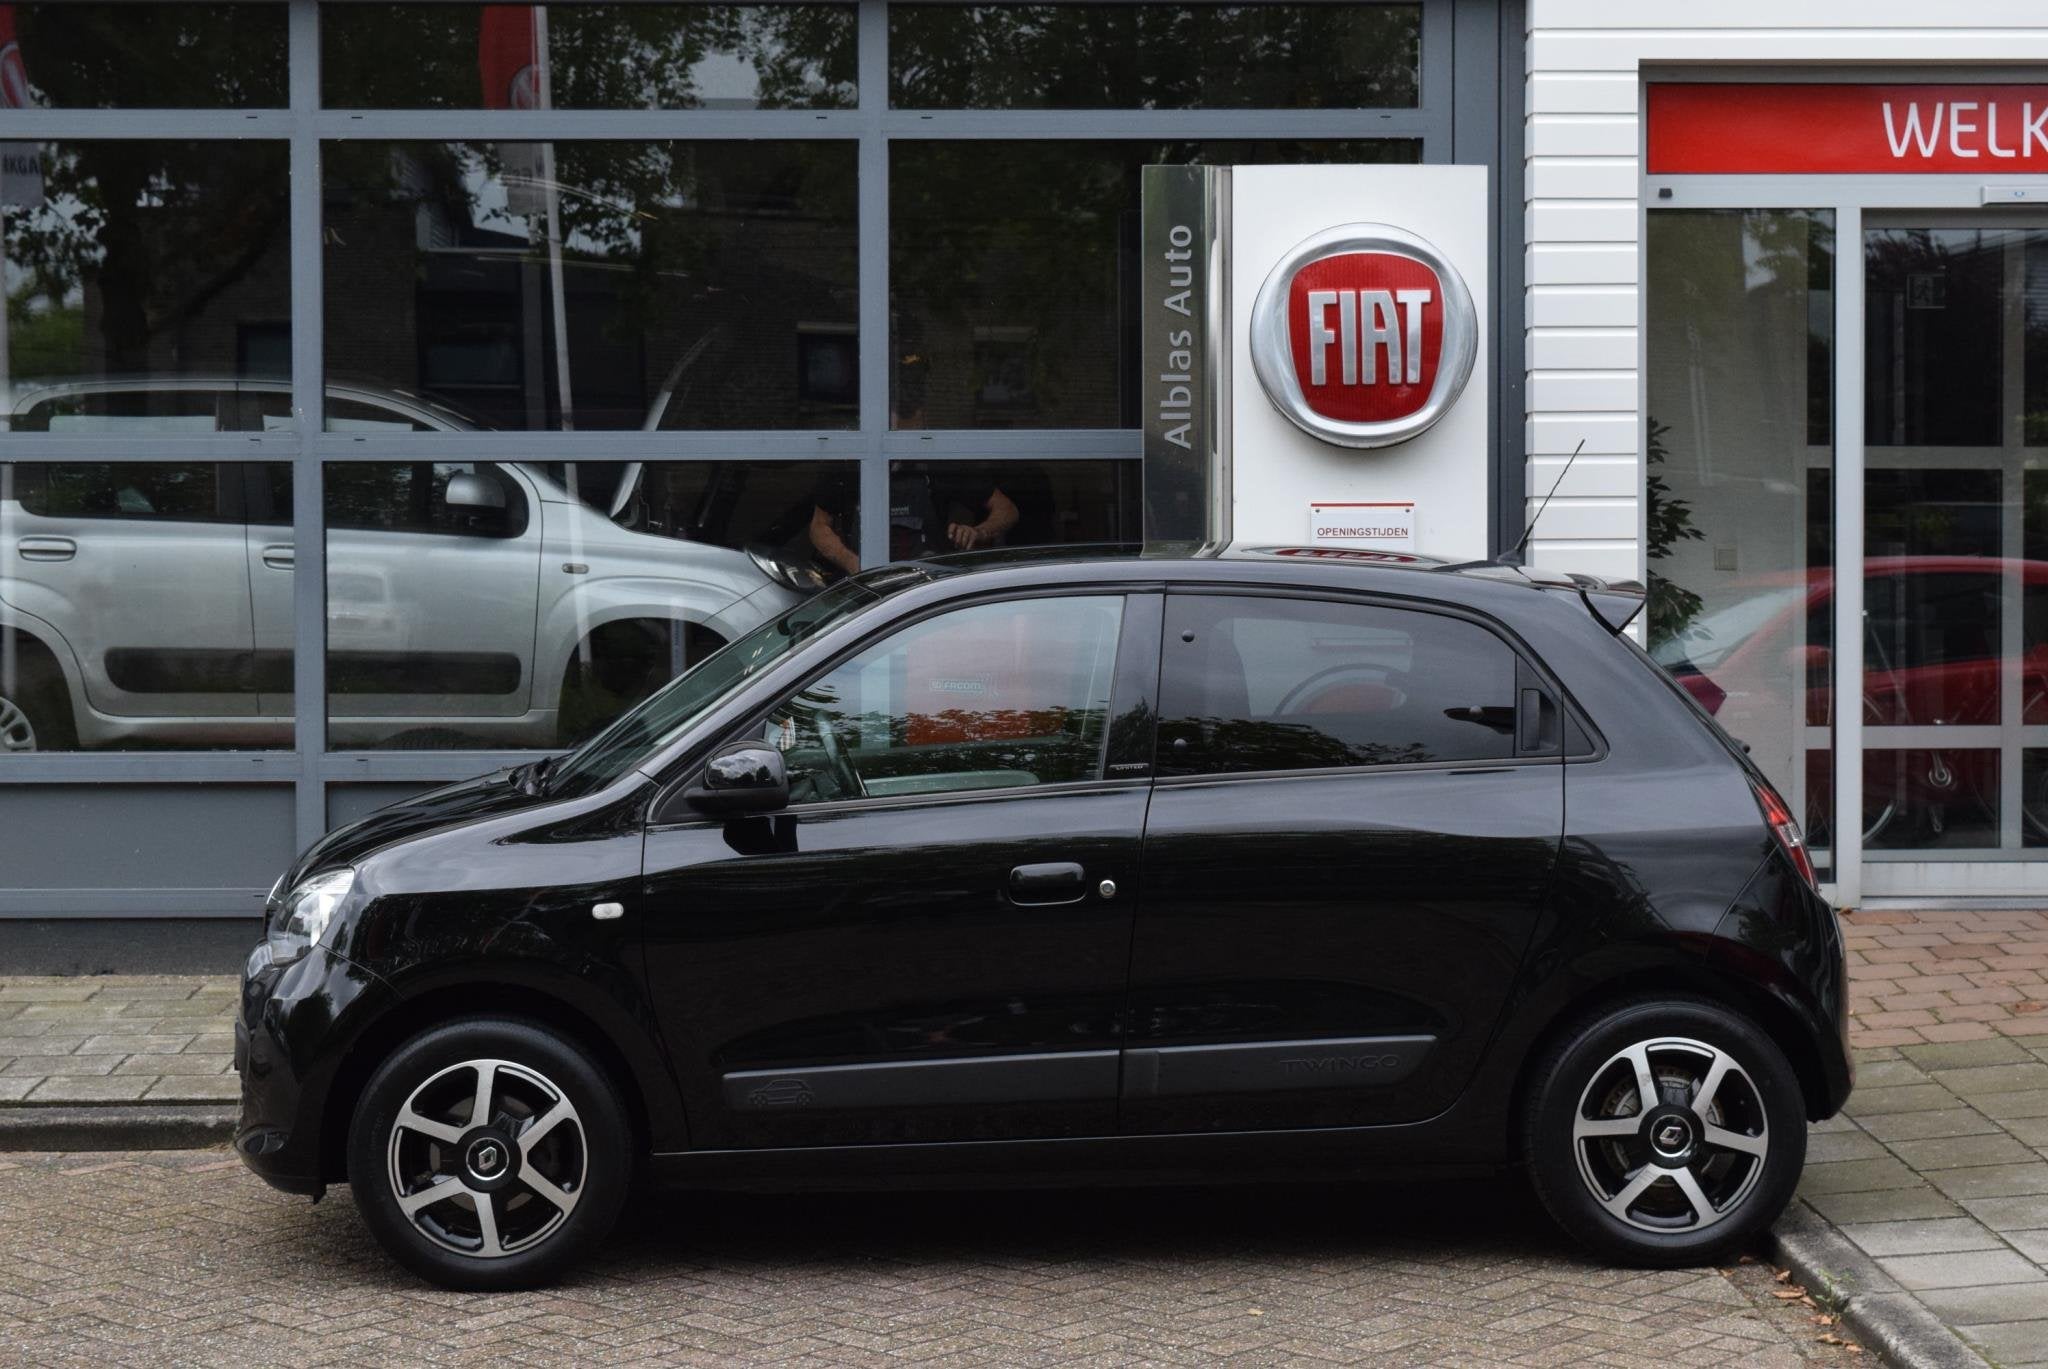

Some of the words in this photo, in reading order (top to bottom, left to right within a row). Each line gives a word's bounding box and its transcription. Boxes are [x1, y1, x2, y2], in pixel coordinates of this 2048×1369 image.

[1164, 225, 1193, 317] Auto
[1308, 289, 1432, 386] FIAT
[1160, 330, 1192, 450] Alblas
[1317, 527, 1408, 537] OPENINGSTIJDEN
[1280, 1054, 1401, 1072] TWINGO
